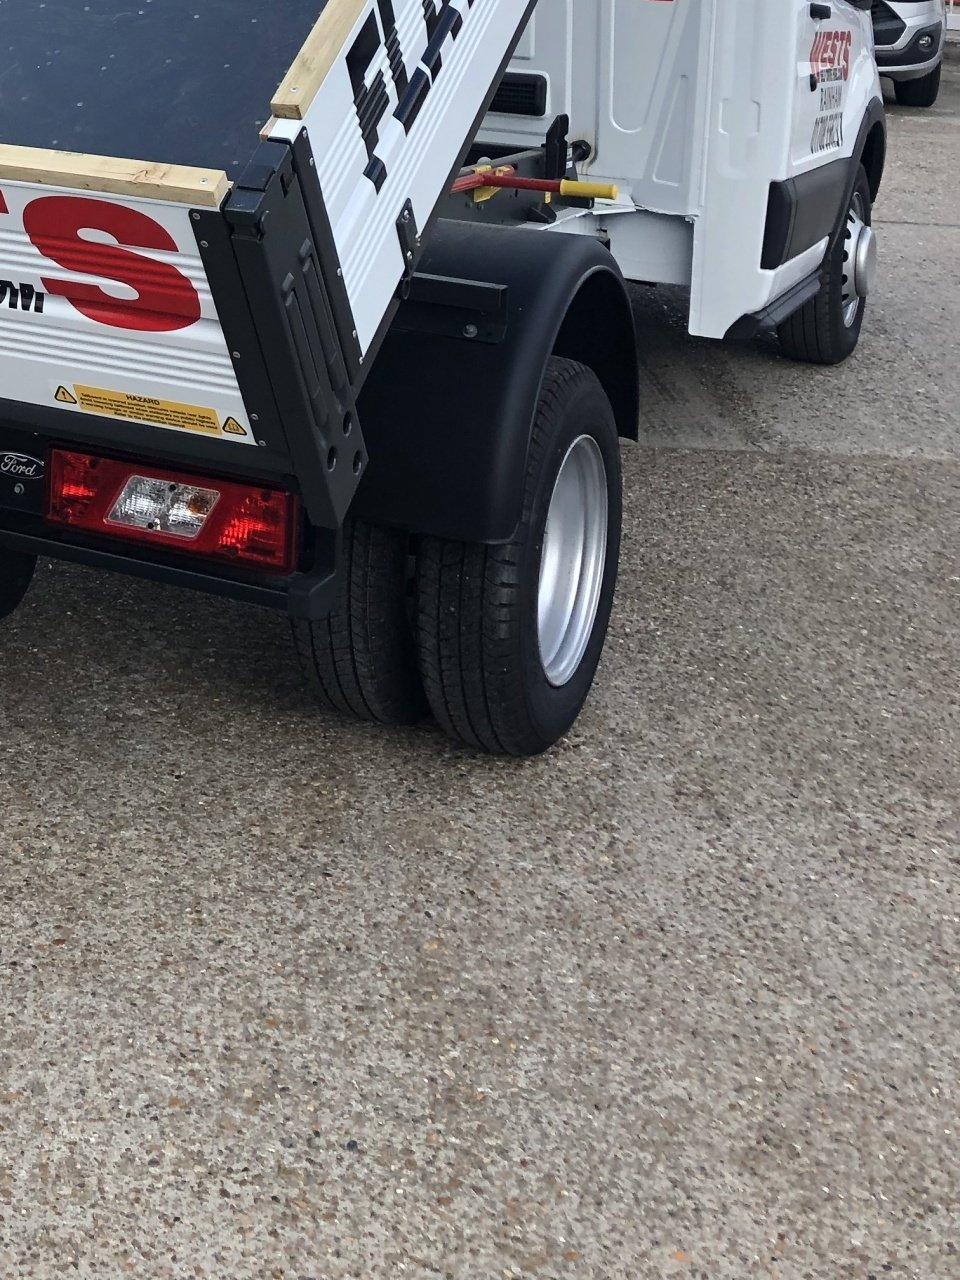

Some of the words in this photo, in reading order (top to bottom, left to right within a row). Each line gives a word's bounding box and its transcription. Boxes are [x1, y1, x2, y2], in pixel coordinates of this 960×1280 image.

[810, 30, 852, 84] WESTS
[125, 394, 161, 406] HAZARD
[0, 454, 37, 476] Ford
